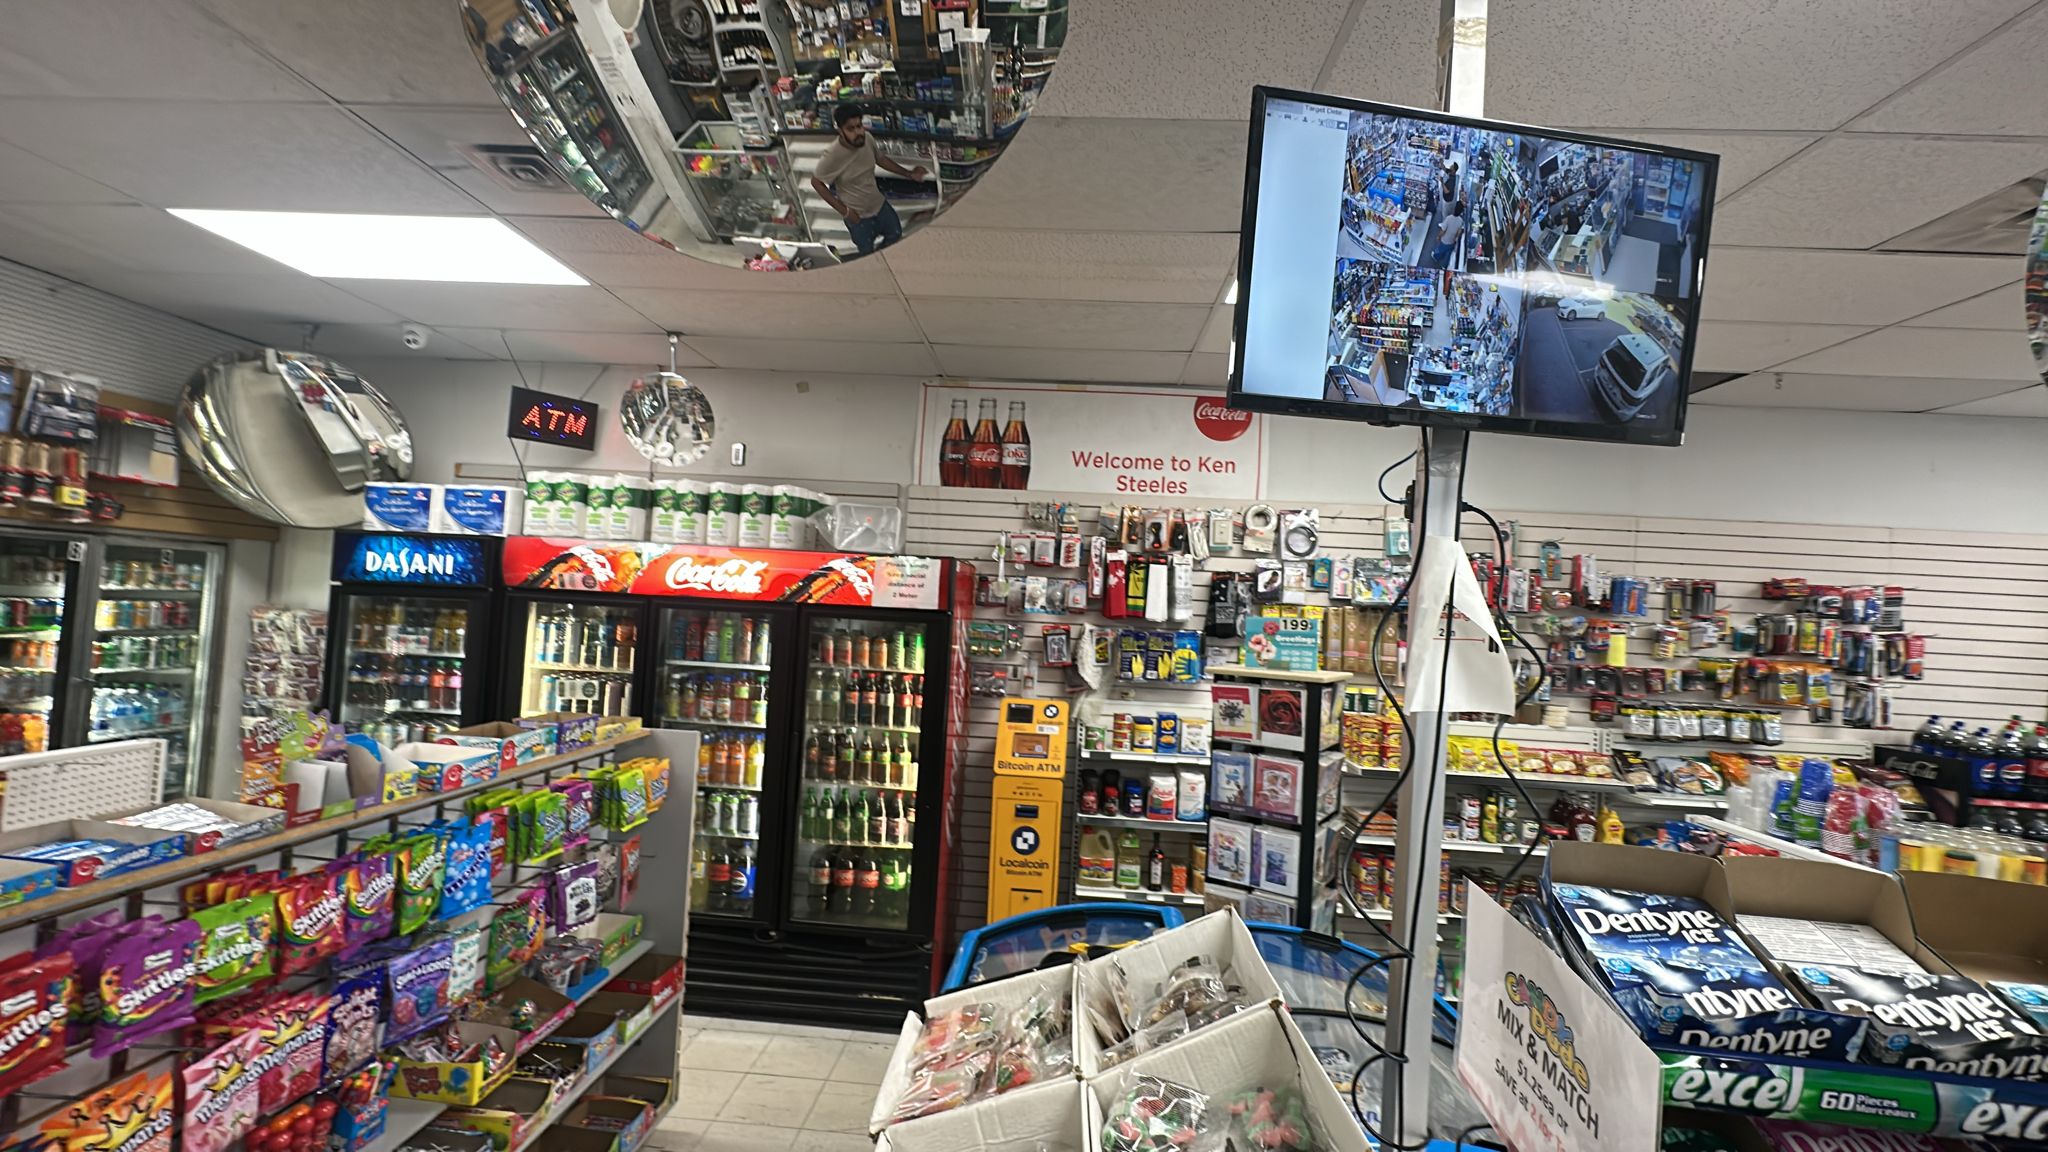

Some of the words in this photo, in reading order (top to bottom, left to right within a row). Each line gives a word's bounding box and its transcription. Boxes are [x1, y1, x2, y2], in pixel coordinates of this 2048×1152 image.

[522, 405, 587, 436] ATM
[1072, 450, 1164, 472] Welcome
[1171, 456, 1191, 473] to
[1199, 456, 1236, 474] Ken
[1116, 475, 1187, 494] Steeles
[366, 547, 454, 577] DASANI
[665, 557, 769, 593] Coca-Cola
[998, 760, 1034, 771] Bitcoin
[1037, 763, 1061, 772] ATM
[1000, 856, 1049, 869] Localcoin
[1574, 907, 1720, 936] Dentyne
[1681, 928, 1721, 944] ICE
[197, 939, 265, 973] Skittles
[118, 962, 197, 1015] Skittles
[1684, 985, 1792, 1018] ntyne
[1679, 1026, 1833, 1053] Dentyne
[1965, 1019, 2016, 1041] ICE
[1494, 1058, 1518, 1097] SAVE
[1497, 998, 1524, 1046] MIX
[1526, 1033, 1538, 1065] &
[1542, 1051, 1599, 1140] MATCH
[1671, 1066, 1804, 1112] excel
[1820, 1090, 1856, 1111] 60
[1856, 1093, 1898, 1107] Pieces
[1856, 1104, 1917, 1118] Morceaux
